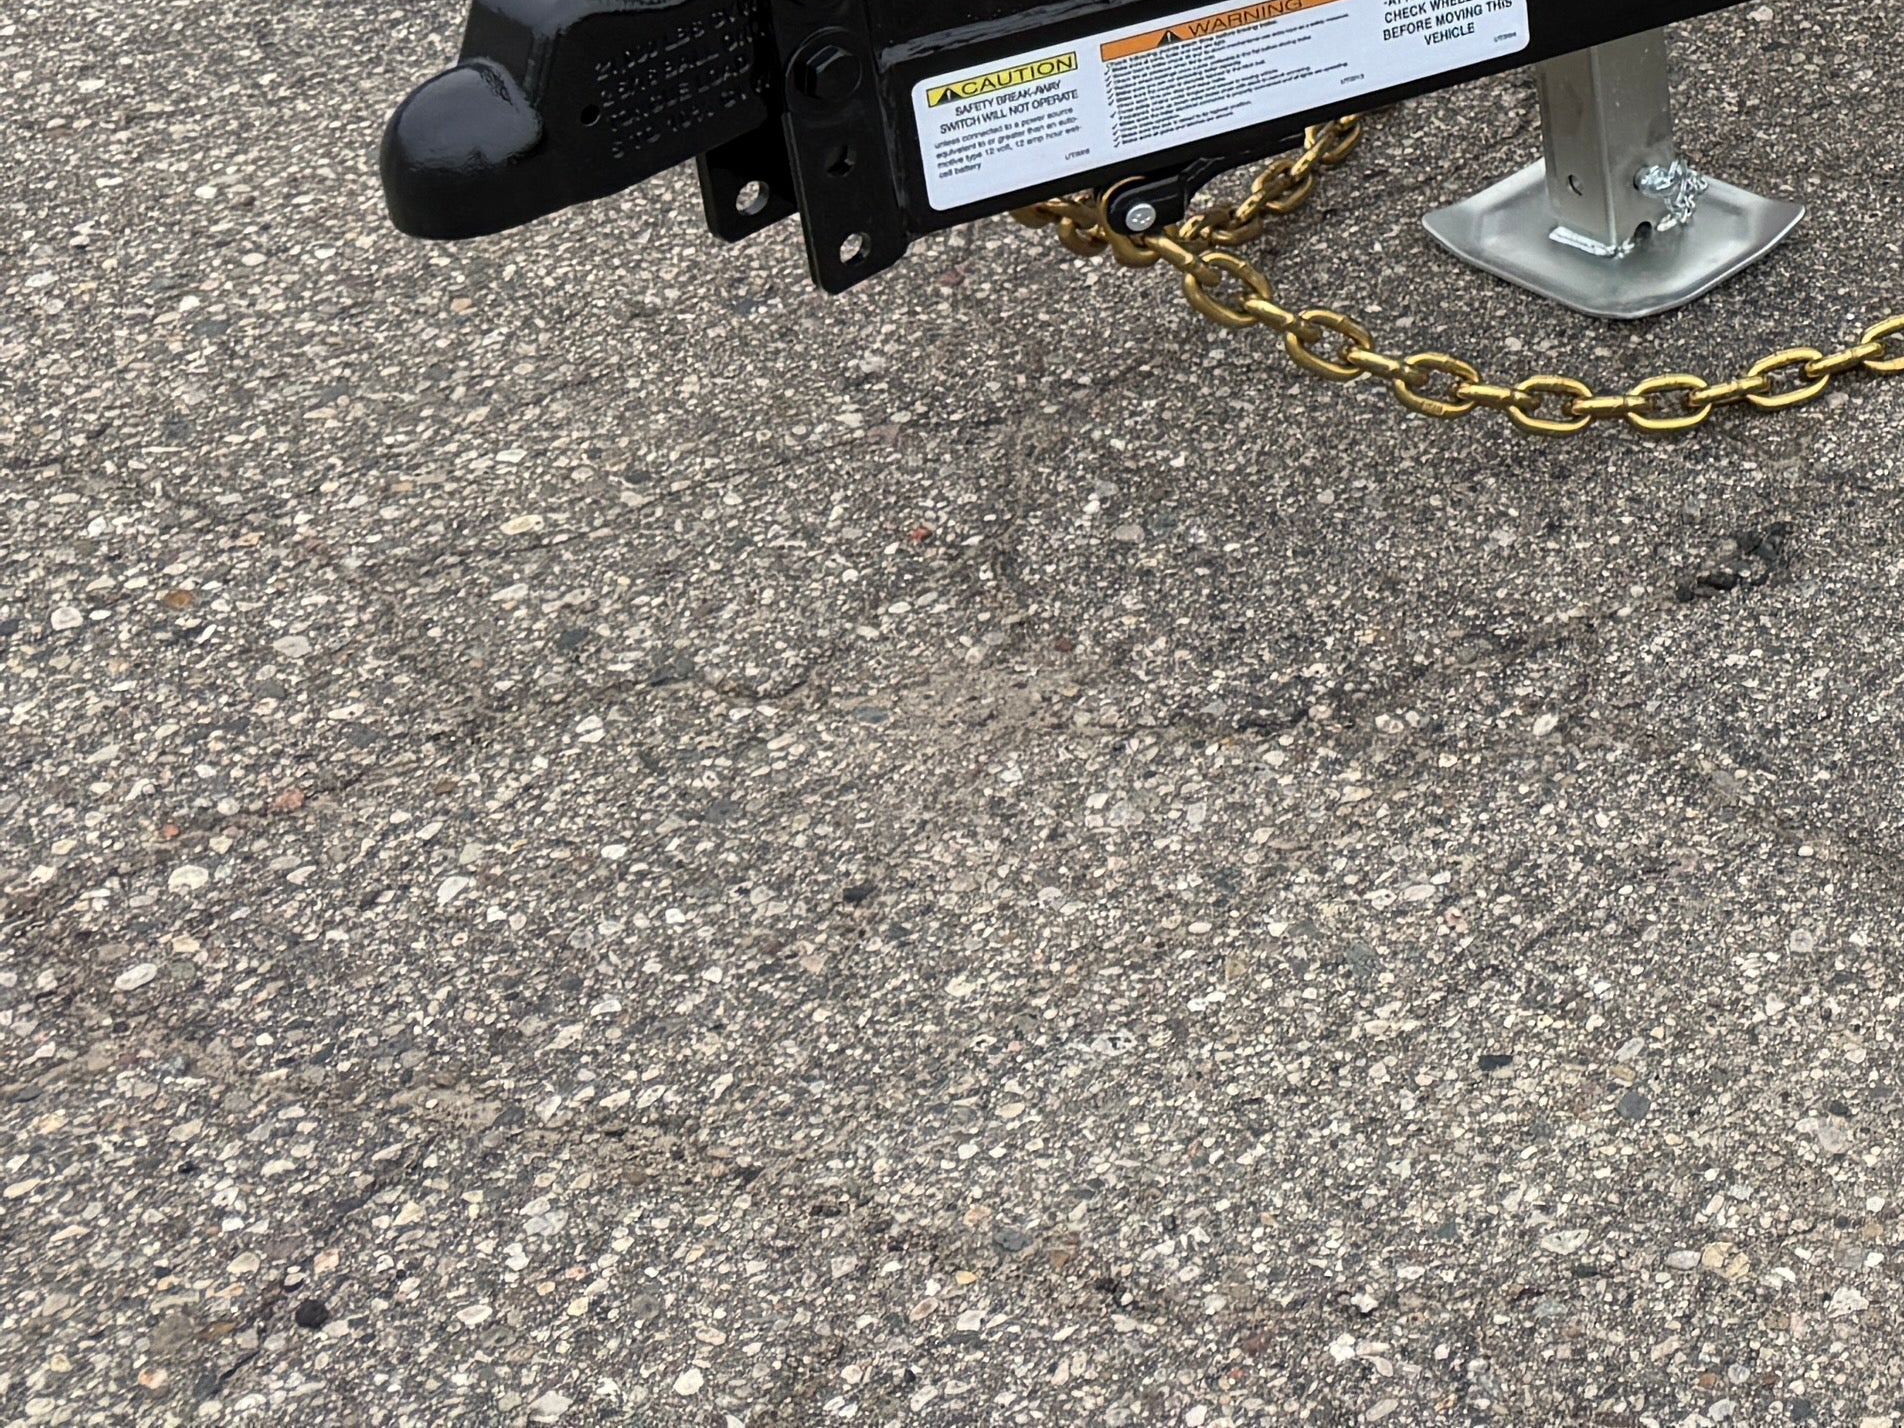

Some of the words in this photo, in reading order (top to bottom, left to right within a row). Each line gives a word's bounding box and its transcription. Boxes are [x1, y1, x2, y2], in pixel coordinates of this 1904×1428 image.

[1383, 18, 1432, 41] BEFORE
[1435, 5, 1482, 26] MOVING
[1385, 2, 1427, 23] CHECK
[1424, 23, 1474, 45] VEHICLE
[961, 55, 1072, 95] CAUTION
[940, 117, 981, 134] SWITCH
[983, 109, 1007, 123] WILL
[1009, 103, 1030, 116] NOT
[1032, 89, 1078, 109] OPERATE
[955, 98, 994, 116] SAFETY
[996, 80, 1061, 106] BREAK-AWAY
[935, 134, 961, 149] unless
[962, 125, 1003, 143] connected
[1021, 114, 1045, 128] power
[1047, 107, 1073, 119] source
[936, 143, 976, 159] equivalent
[999, 130, 1025, 144] greater
[1027, 125, 1045, 135] than
[938, 156, 963, 169] motive
[966, 152, 982, 164] type
[985, 147, 995, 156] 12
[1026, 135, 1044, 146] amp
[1046, 130, 1063, 140] hour
[939, 168, 953, 179] cell
[954, 162, 981, 175] battery
